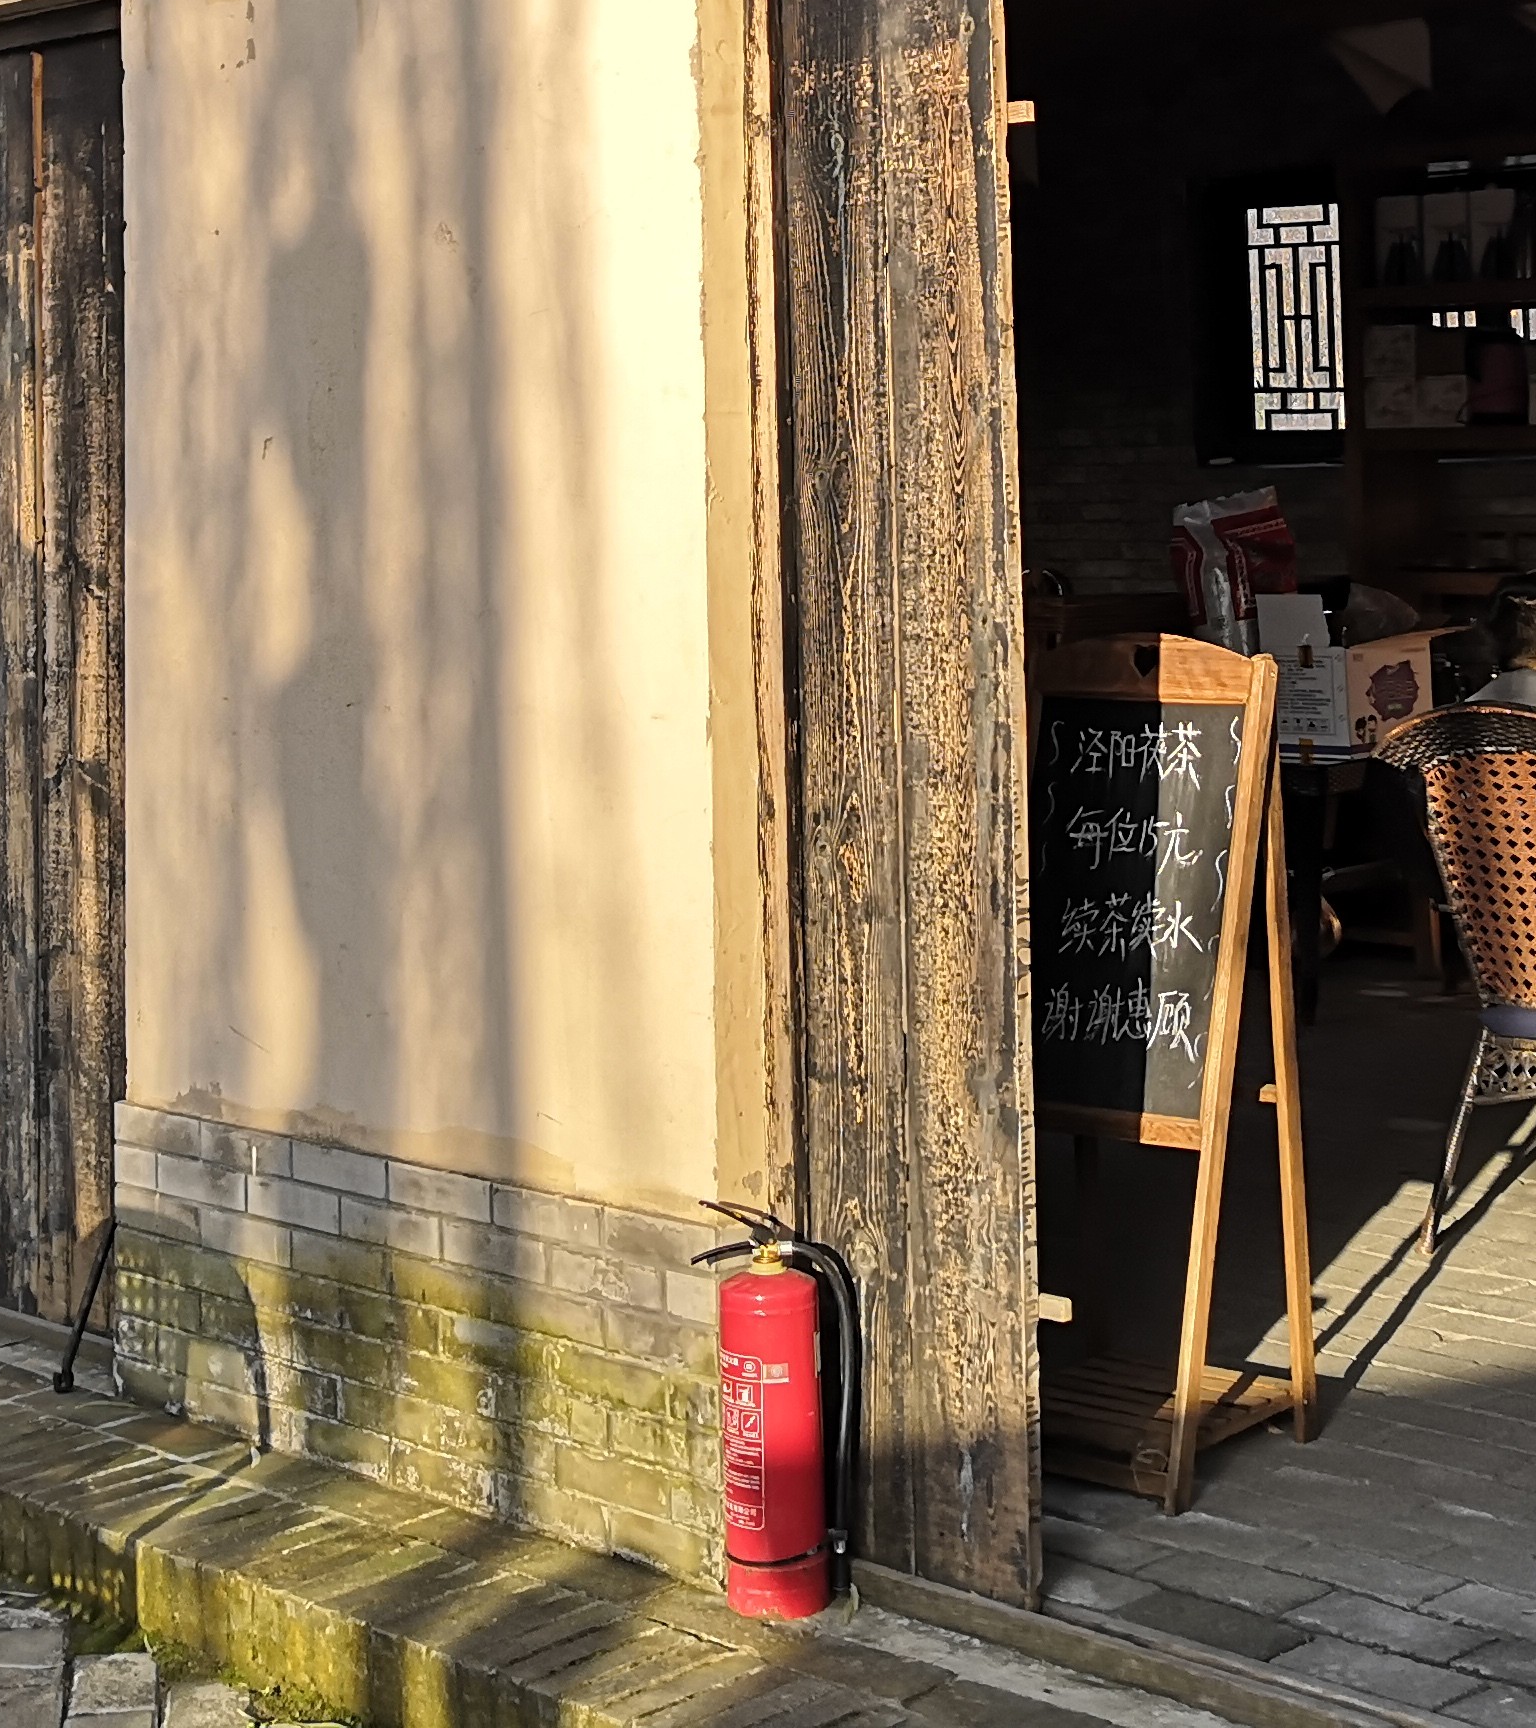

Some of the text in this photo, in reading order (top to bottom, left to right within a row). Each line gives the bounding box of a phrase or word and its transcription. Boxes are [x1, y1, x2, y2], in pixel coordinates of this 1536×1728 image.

[1069, 721, 1203, 791] 泾阳茯茶
[1041, 977, 1195, 1064] 谢谢惠顾
